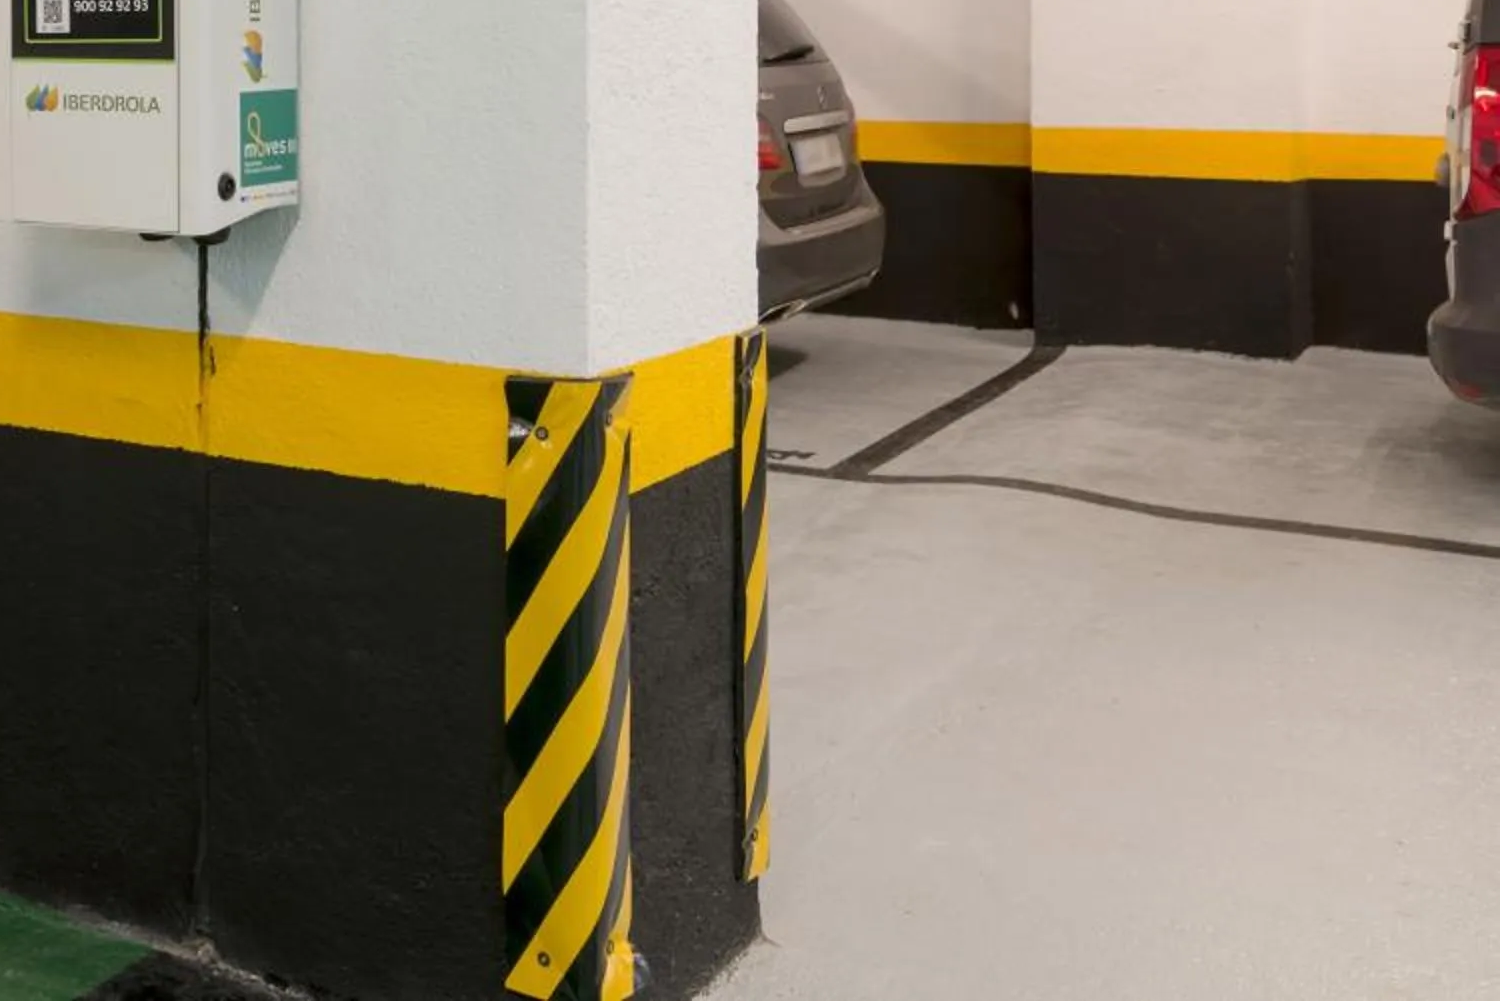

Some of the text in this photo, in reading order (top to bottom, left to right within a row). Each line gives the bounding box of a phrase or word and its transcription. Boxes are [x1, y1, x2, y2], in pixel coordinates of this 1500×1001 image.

[73, 0, 97, 13] 900
[98, 0, 113, 12] 92
[62, 94, 161, 113] IBERDROLA
